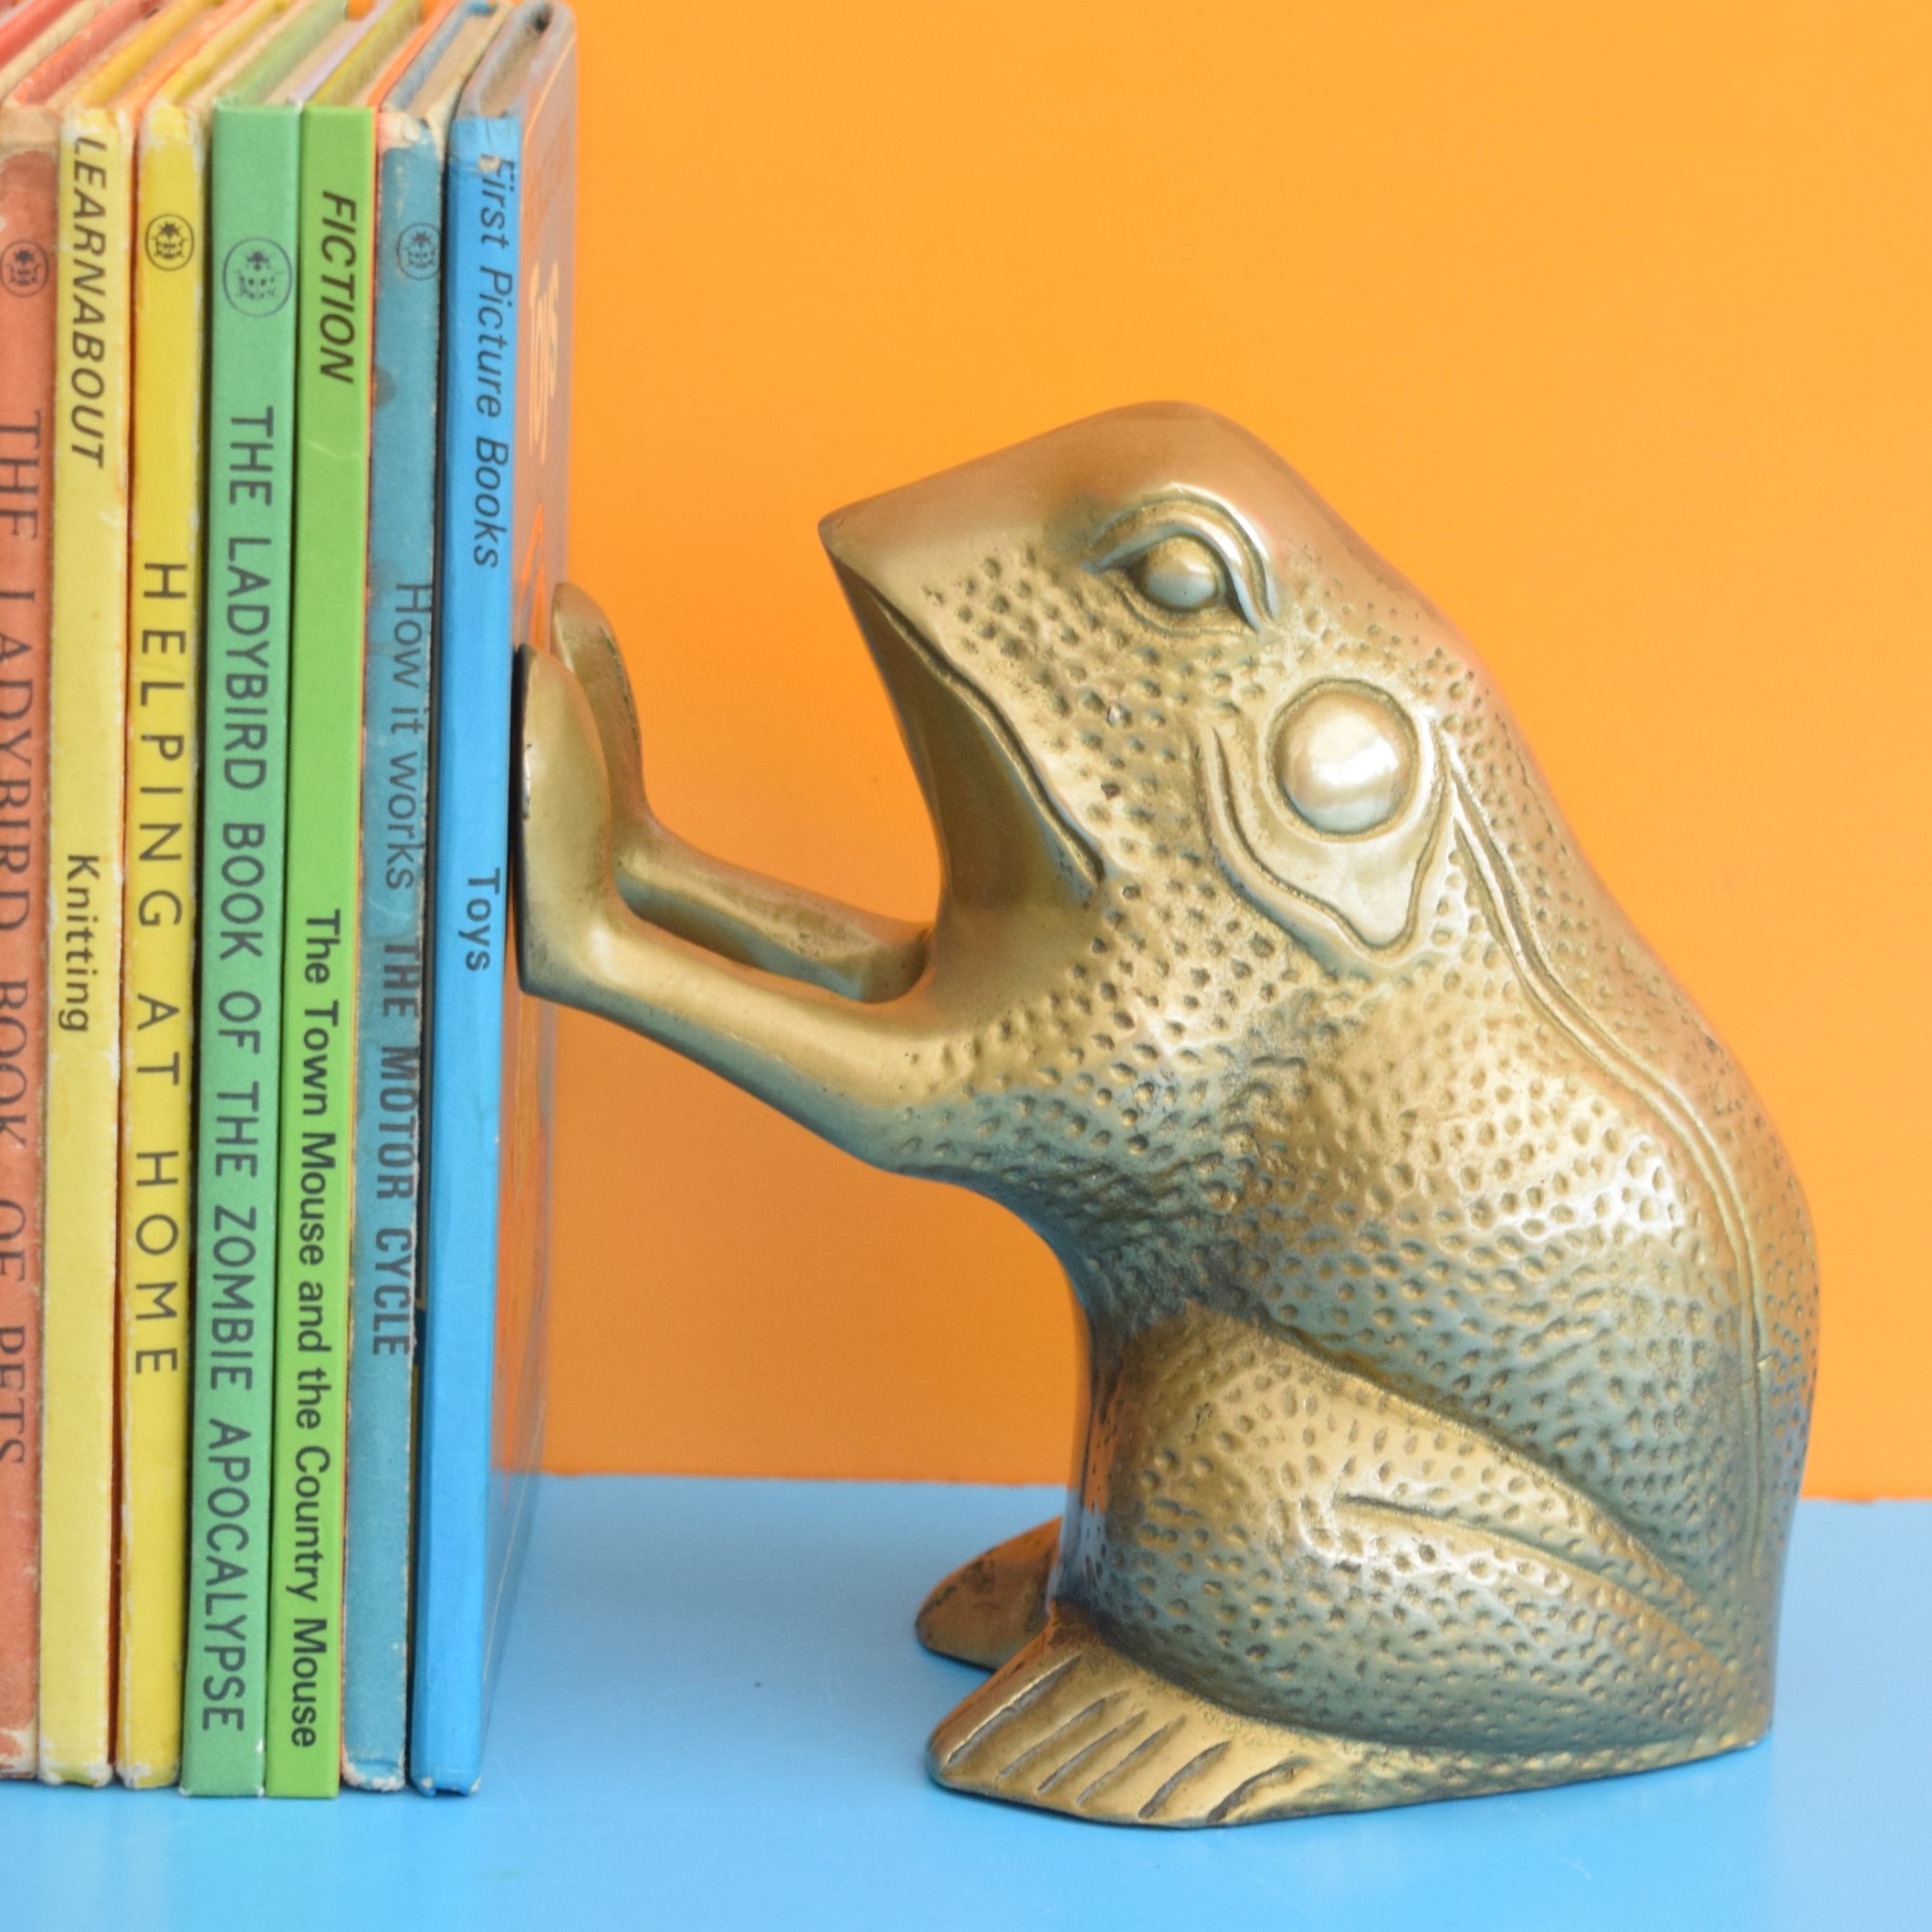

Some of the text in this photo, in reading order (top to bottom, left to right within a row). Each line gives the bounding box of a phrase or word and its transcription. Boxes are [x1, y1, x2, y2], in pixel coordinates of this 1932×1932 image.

[69, 137, 109, 468] LEARNABOUT
[318, 190, 359, 384] FICTION
[473, 152, 518, 569] First Picture Books
[0, 409, 42, 541] THE
[386, 582, 433, 891] How it works
[0, 977, 30, 1149] BOOK
[56, 852, 100, 1034] Knitting
[135, 562, 189, 1377] HELPING AT HOME
[202, 404, 276, 1732] THE LADYBIRD BOOK OF THE ZOMBIE APOCALYPSE
[458, 867, 501, 973] Toys
[372, 943, 424, 1357] THE MOTOR CYCLE
[285, 909, 341, 1749] The Town Mouse and the Country Mouse
